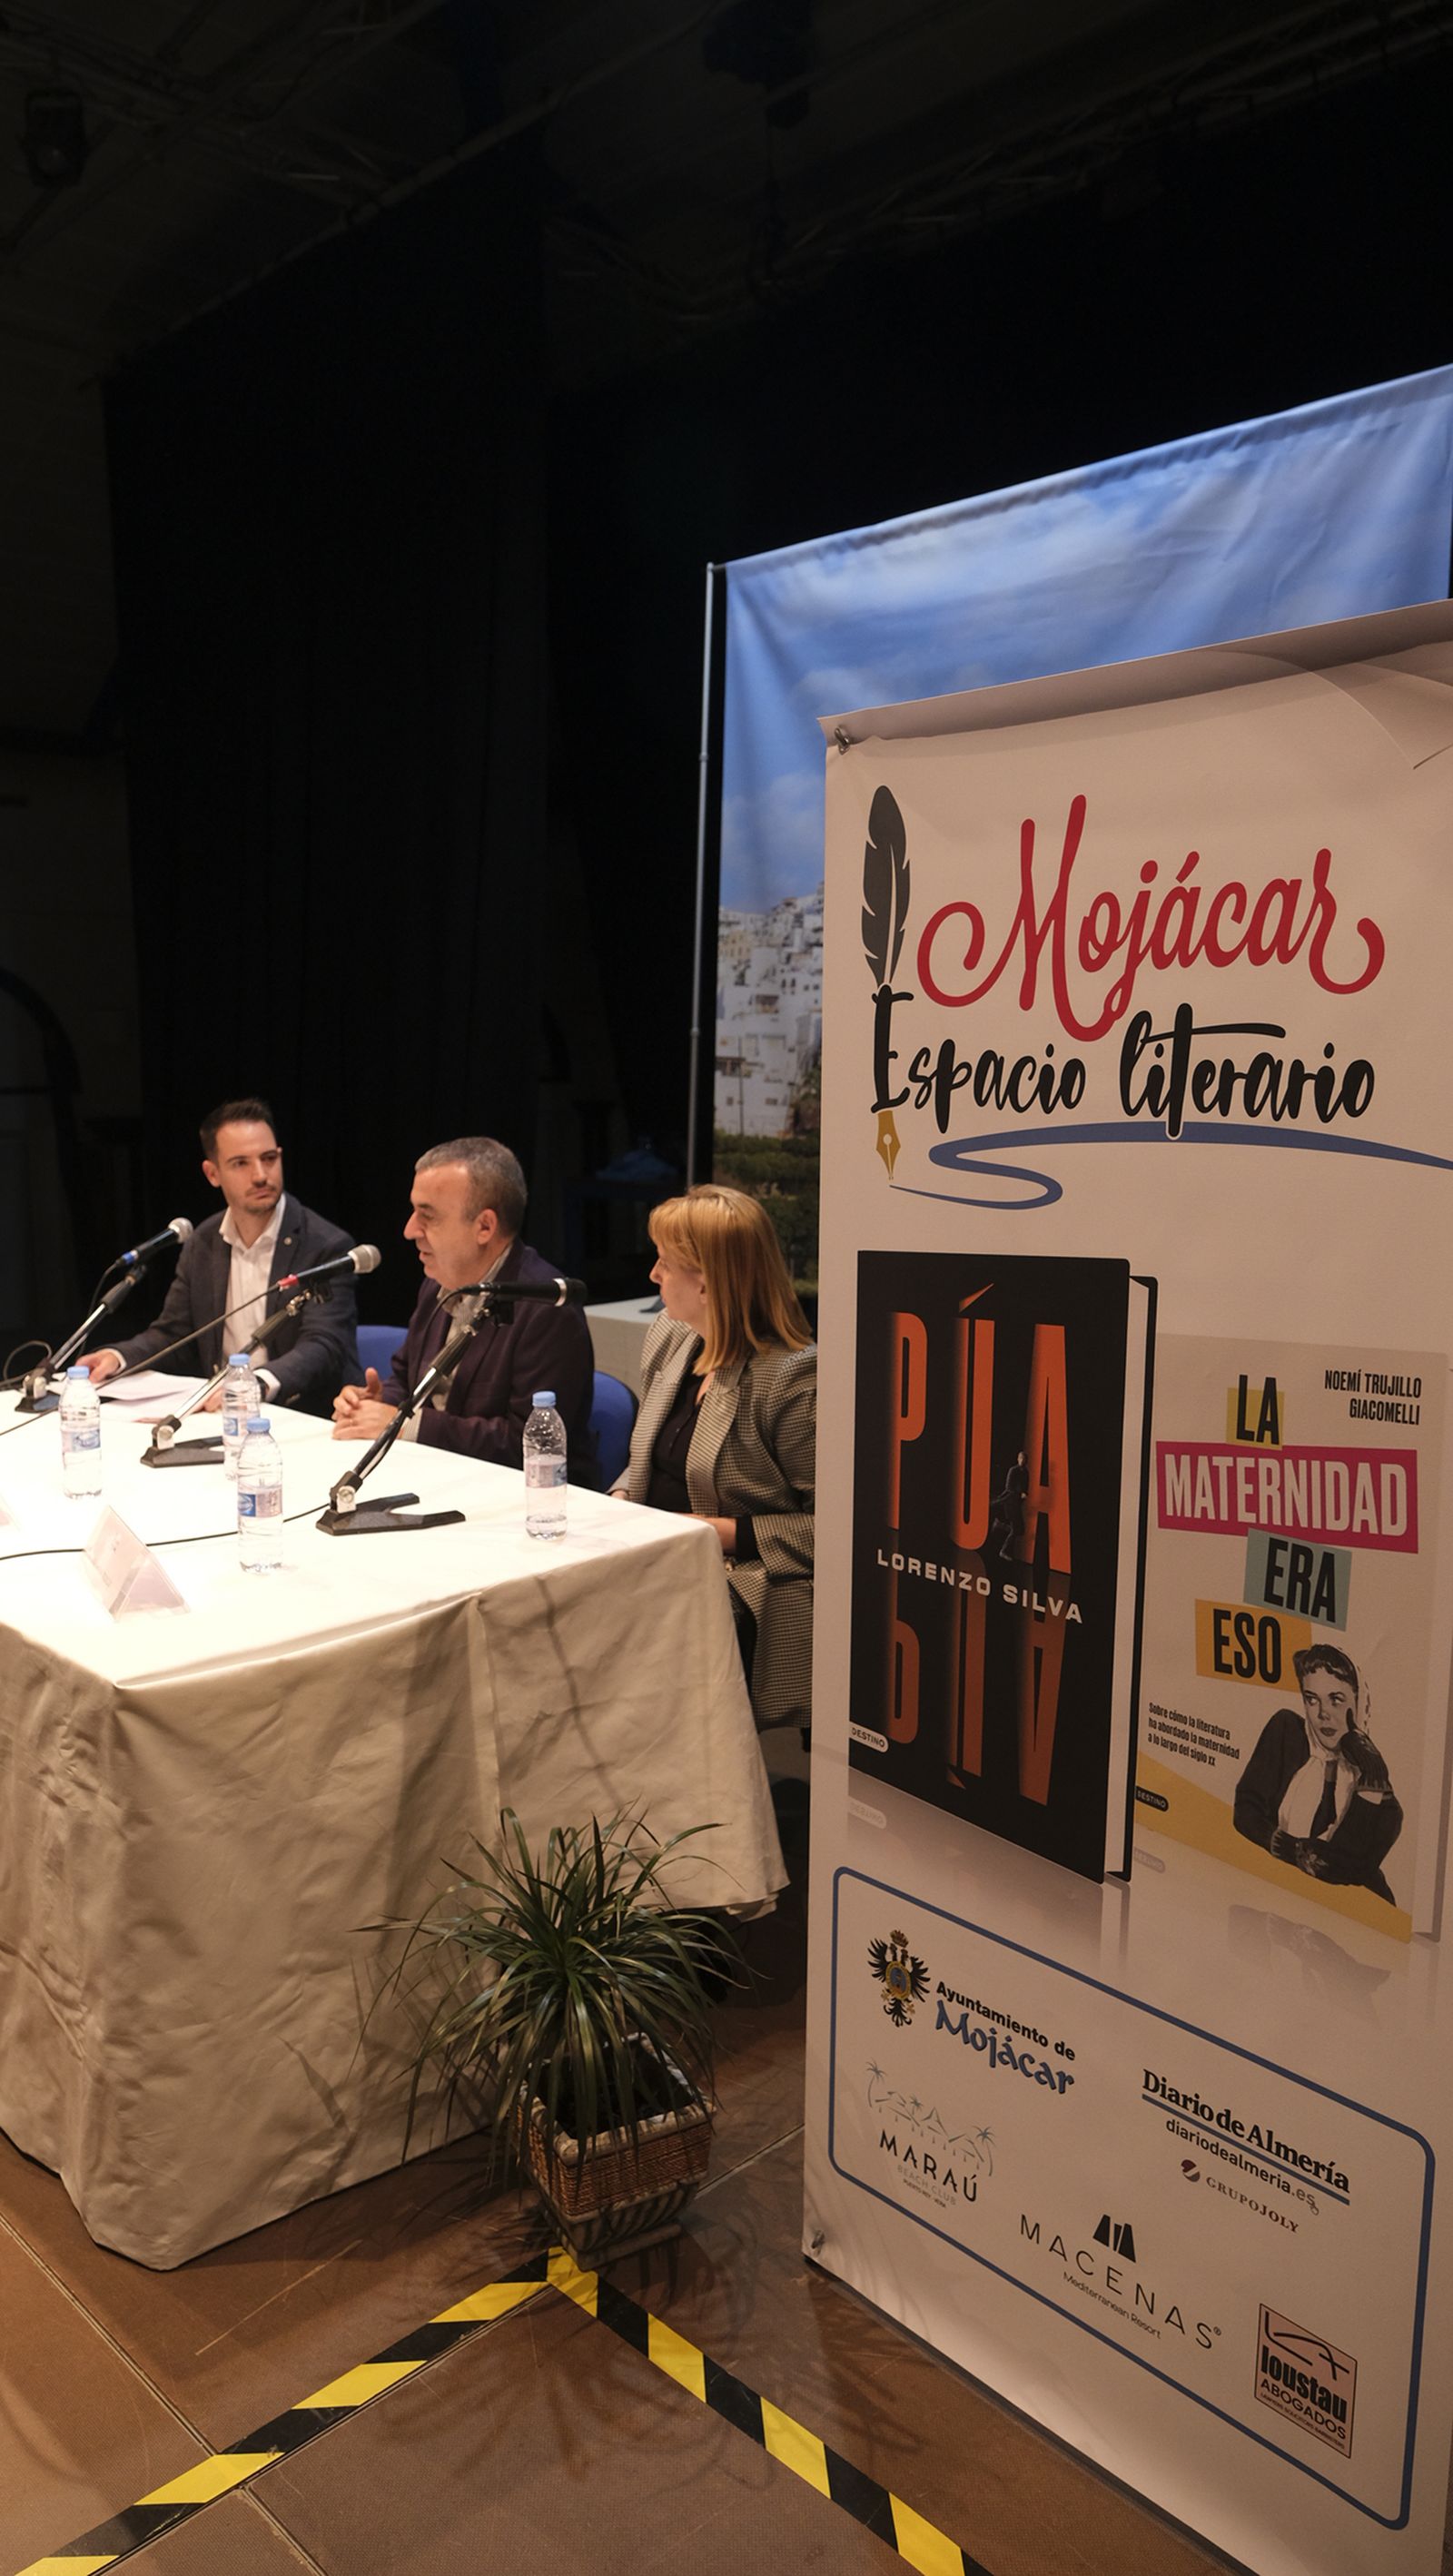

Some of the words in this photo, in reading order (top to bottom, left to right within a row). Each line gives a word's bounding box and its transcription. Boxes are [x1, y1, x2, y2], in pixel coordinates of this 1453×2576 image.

[916, 794, 1386, 1042] Mojácar
[870, 983, 1087, 1134] Espacio
[1119, 1002, 1376, 1138] literario
[1235, 1374, 1280, 1446] LA
[1324, 1368, 1362, 1393] NOEMÍ
[1365, 1373, 1422, 1399] TRUJILLO
[1349, 1398, 1420, 1426] GIACOMELLI
[886, 1282, 1072, 1575] PÚA
[1163, 1453, 1409, 1537] MATERNIDAD
[876, 1548, 992, 1597] LORENZO
[1002, 1583, 1083, 1624] SILVA
[1263, 1536, 1337, 1624] ERA
[1212, 1607, 1282, 1684] ESO
[851, 1727, 885, 1749] DESTINO
[1148, 1702, 1169, 1719] Sobre
[1169, 1709, 1188, 1726] cómo
[1188, 1714, 1196, 1728] la
[1196, 1717, 1231, 1741] literatura
[1148, 1717, 1157, 1730] ha
[1157, 1720, 1190, 1742] abordado
[1190, 1730, 1198, 1744] la
[1198, 1734, 1240, 1760] maternidad
[1152, 1734, 1161, 1745] lo
[1160, 1737, 1178, 1753] largo
[1178, 1742, 1190, 1757] del
[1190, 1747, 1208, 1764] siglo
[1136, 1790, 1167, 1809] DESTINO
[934, 1999, 1075, 2095] Mojácar
[936, 1980, 1049, 2048] Ayuntamiento
[1053, 2040, 1076, 2061] de
[879, 2129, 977, 2203] MARAÚ
[1165, 2118, 1316, 2207] diariodealmeria.es
[1063, 2271, 1131, 2321] Mediterranean
[1130, 2313, 1161, 2340] Resort
[1260, 2378, 1347, 2440] ABOGADOS
